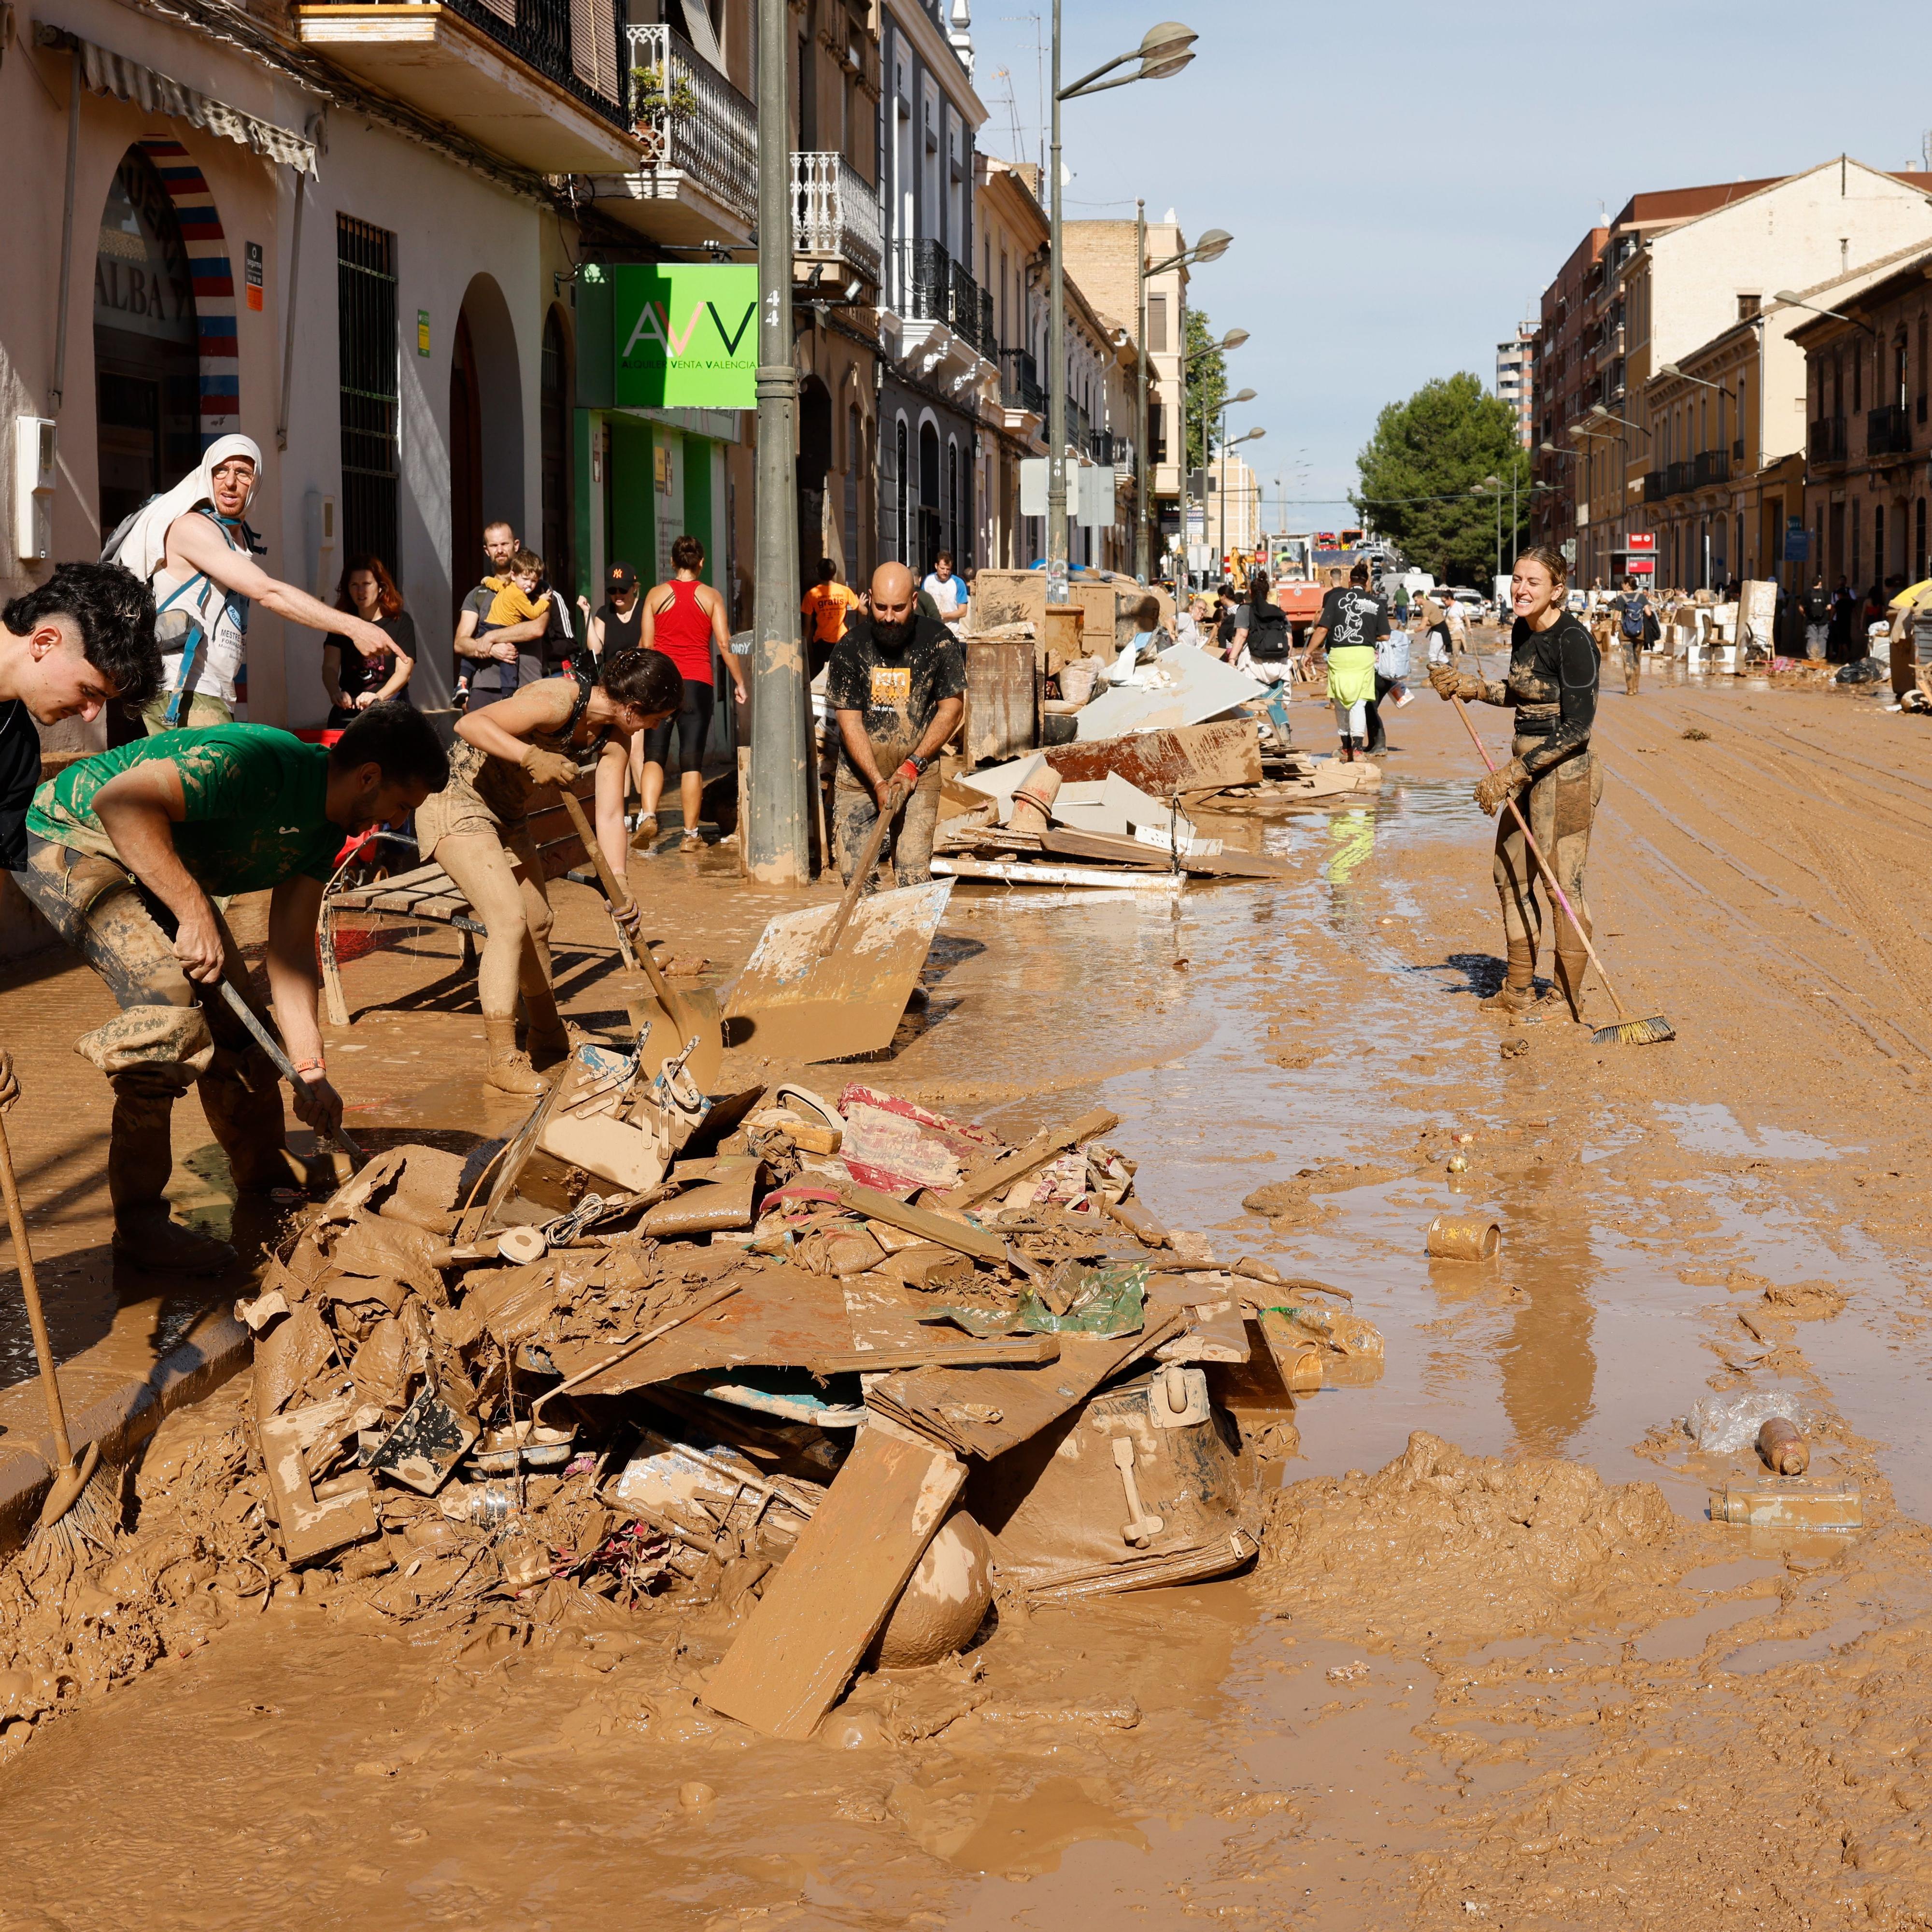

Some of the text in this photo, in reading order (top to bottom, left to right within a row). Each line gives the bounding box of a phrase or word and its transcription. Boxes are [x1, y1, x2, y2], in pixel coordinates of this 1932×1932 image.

[622, 301, 757, 357] AVV
[622, 360, 756, 370] ALQUILER VENTA VALENCIA
[612, 568, 623, 579] NY
[818, 597, 844, 609] gratis
[220, 629, 241, 642] MESTRE
